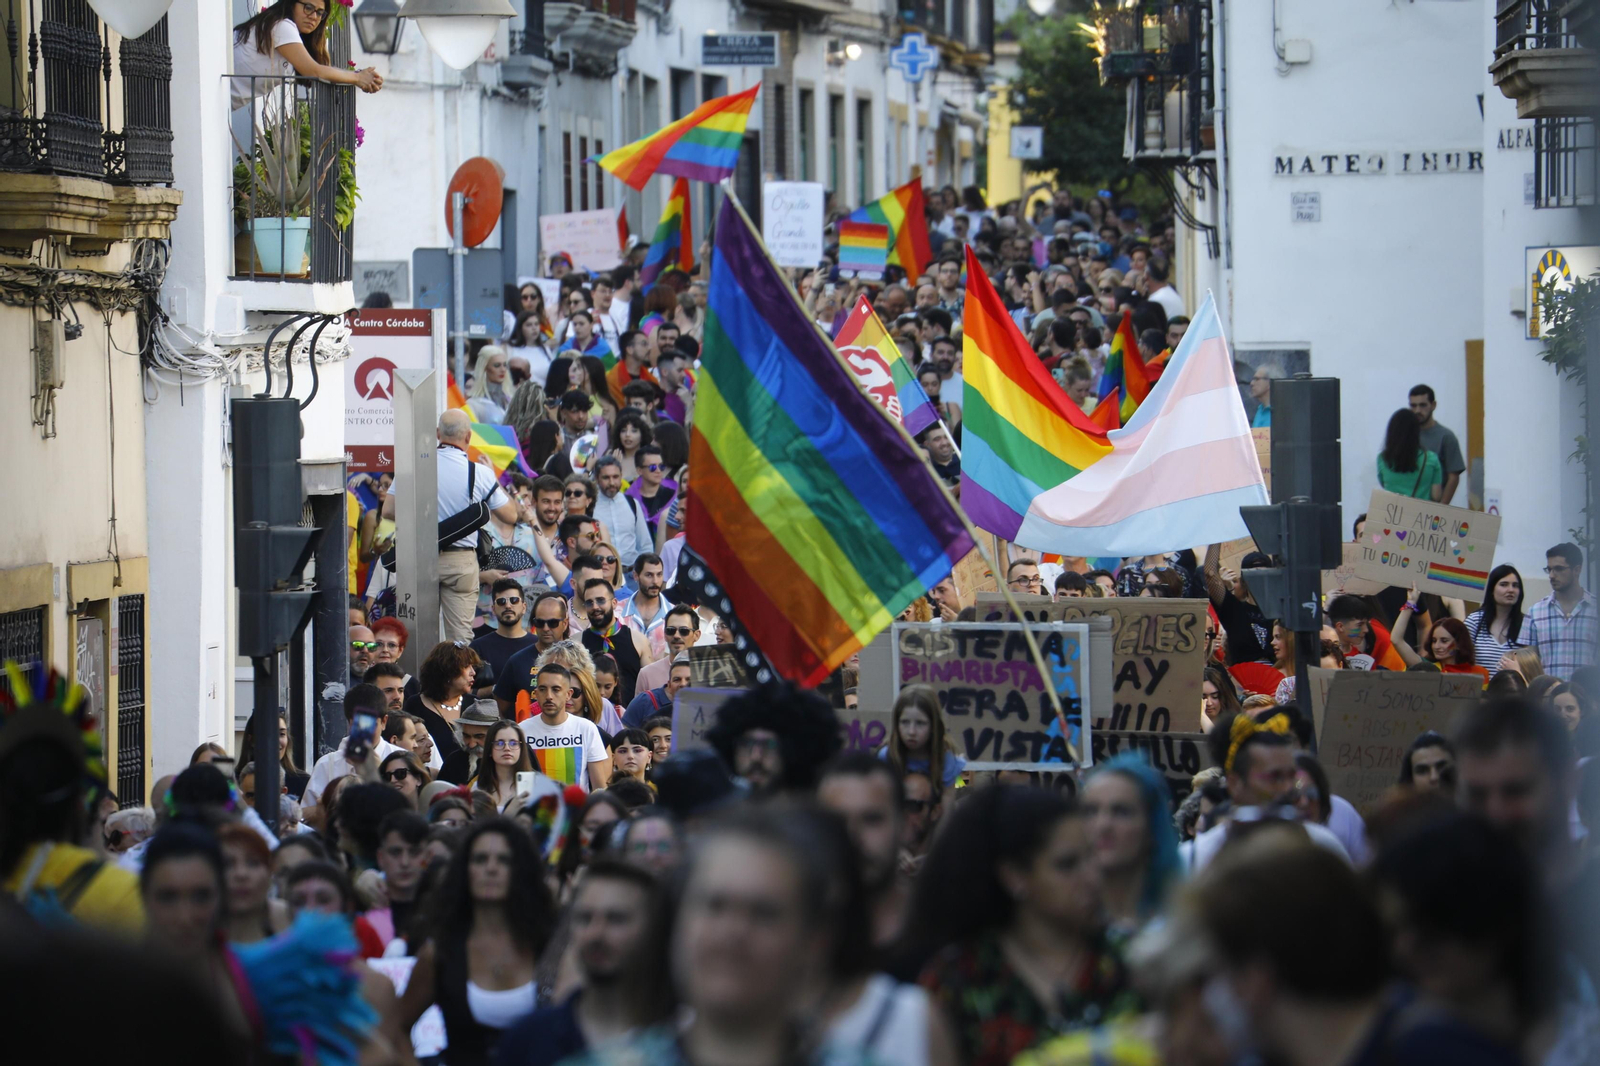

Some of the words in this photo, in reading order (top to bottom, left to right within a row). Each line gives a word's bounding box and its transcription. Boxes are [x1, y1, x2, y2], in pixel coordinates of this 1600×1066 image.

[1274, 154, 1384, 174] MATEO
[353, 318, 383, 328] Centro
[386, 317, 425, 328] Córdoba
[345, 407, 355, 415] tro
[357, 407, 393, 415] Comercia
[375, 415, 394, 425] CÓR
[1384, 503, 1404, 526] SU
[1412, 512, 1447, 533] AMOR
[1450, 520, 1469, 538] NO
[1407, 530, 1447, 557] DAÑA
[1362, 546, 1376, 561] TU
[1381, 551, 1410, 568] ODIO
[901, 657, 1046, 693] BINARISTA
[1113, 657, 1170, 695] AY
[937, 686, 1029, 722] ERA
[1378, 688, 1435, 712] SOMOS
[526, 734, 583, 748] Polaroid
[963, 727, 1074, 763] VISTA
[1337, 743, 1403, 769] BASTAR
